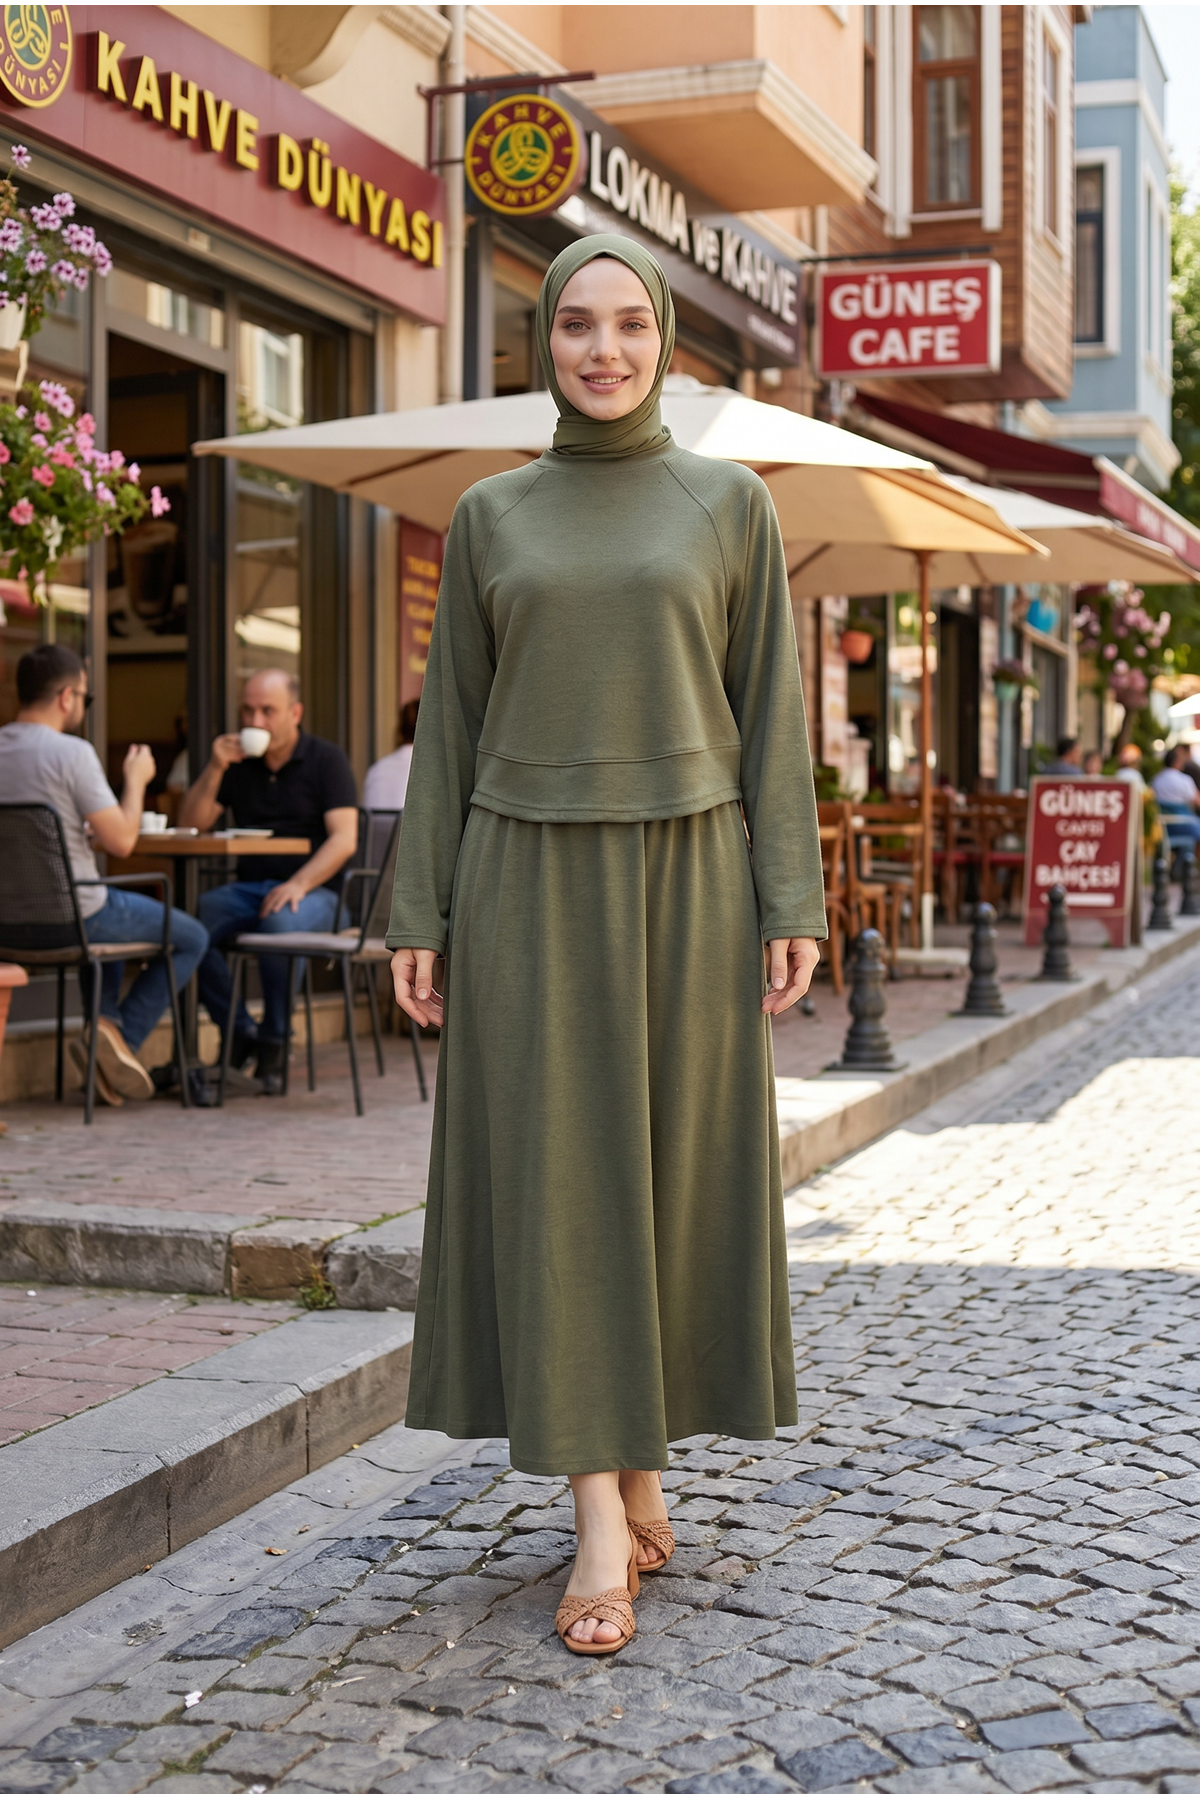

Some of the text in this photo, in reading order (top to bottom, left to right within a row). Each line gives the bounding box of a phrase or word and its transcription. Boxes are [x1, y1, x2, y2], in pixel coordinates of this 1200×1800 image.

[476, 104, 567, 148] KAHVE
[98, 30, 443, 269] KAHVE DÜNYASI
[590, 131, 690, 255] LOKMA
[721, 226, 797, 326] KAHVE
[829, 274, 982, 323] GÜNEŞ
[848, 325, 961, 366] CAFE
[1039, 784, 1124, 822] GÜNEŞ
